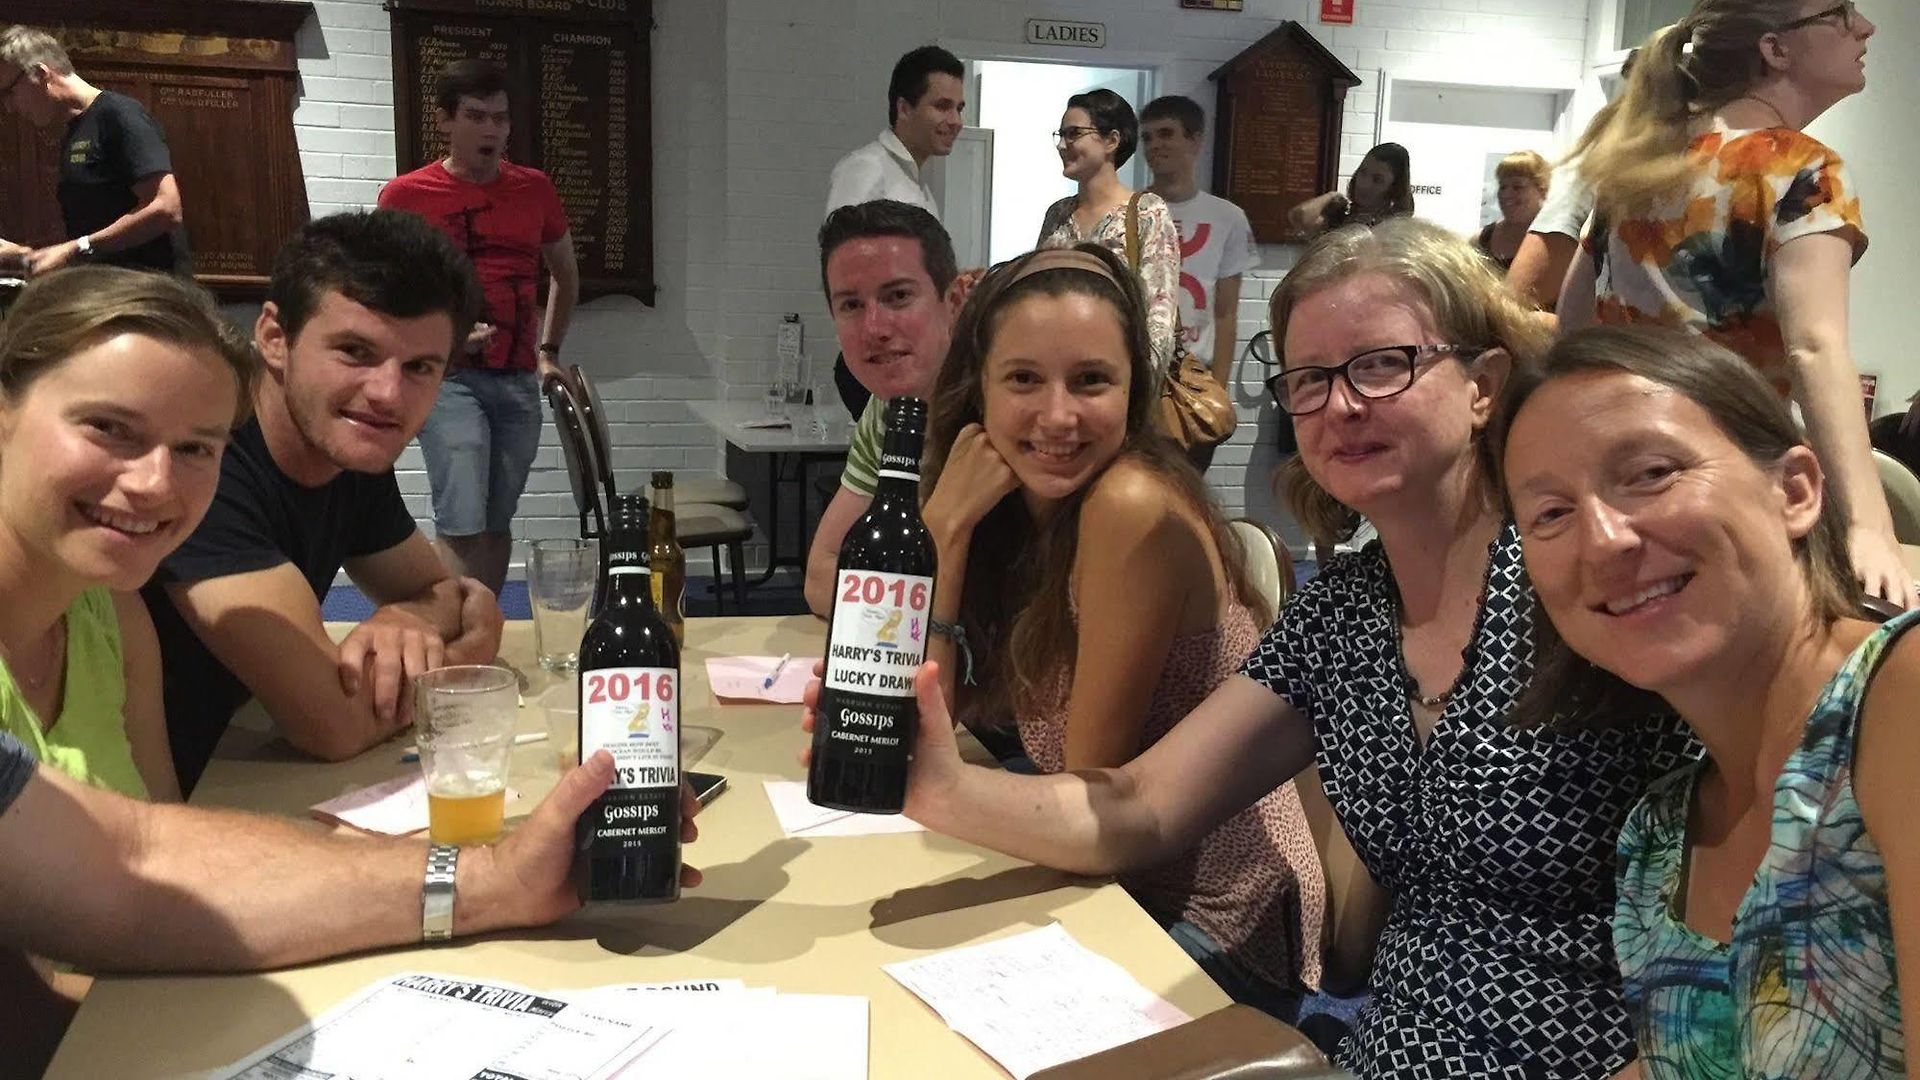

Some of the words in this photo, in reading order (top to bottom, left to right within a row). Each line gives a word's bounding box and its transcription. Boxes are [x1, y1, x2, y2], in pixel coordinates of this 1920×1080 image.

[433, 25, 494, 36] PRESIDENT
[553, 33, 613, 46] CHAMPION
[1034, 24, 1098, 43] LADIES
[1410, 185, 1442, 195] OFFICE
[882, 454, 916, 467] Gossips
[842, 574, 927, 611] 2016
[832, 644, 882, 663] HARRY'S
[886, 651, 920, 668] TRIVIA
[589, 672, 674, 704] 2016
[834, 668, 876, 686] LUCKY
[880, 674, 914, 692] DRAW
[840, 708, 895, 730] Gossips
[831, 730, 870, 743] CABERNET
[870, 736, 899, 746] MERLOT
[640, 766, 676, 785] TRIVIA
[604, 805, 659, 824] Gossips
[597, 827, 637, 837] CABERNET
[637, 826, 668, 835] MERLOT
[394, 976, 477, 1000] HARRY'S
[471, 985, 536, 1013] TRIVIA
